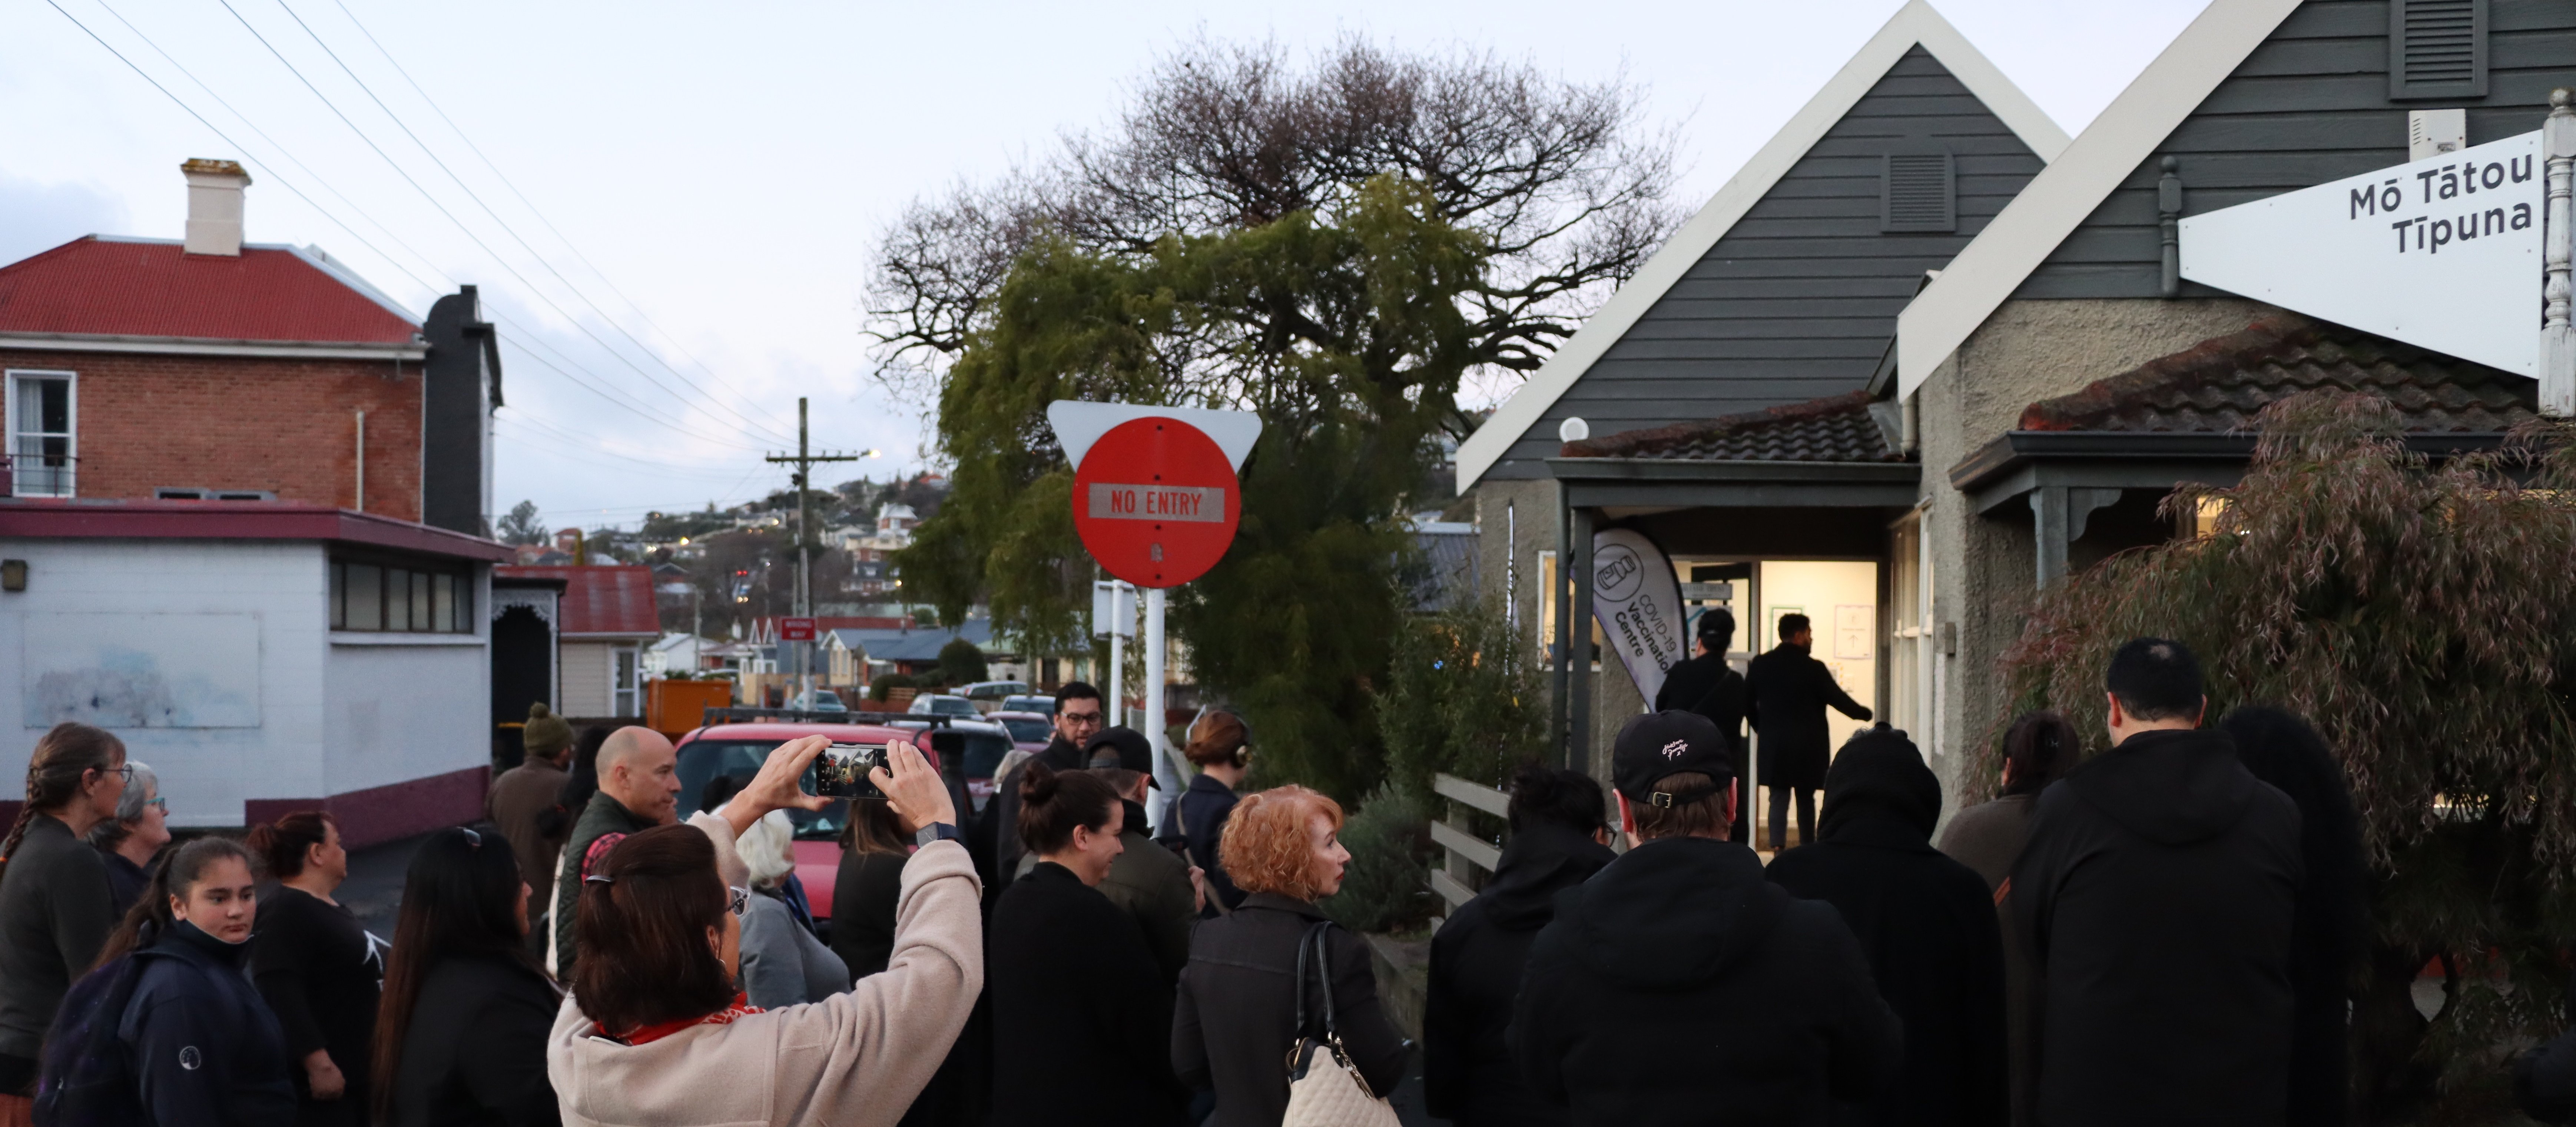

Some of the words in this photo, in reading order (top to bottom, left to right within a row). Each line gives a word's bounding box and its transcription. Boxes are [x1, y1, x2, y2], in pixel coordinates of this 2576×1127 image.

[2350, 178, 2402, 220] Mō
[2417, 154, 2532, 204] Tātou
[2392, 202, 2532, 255] Tīpuna
[1111, 490, 1136, 513] NO
[1147, 491, 1202, 516] ENTRY
[1615, 611, 1644, 657] Centre
[1638, 593, 1677, 653] COVID-19
